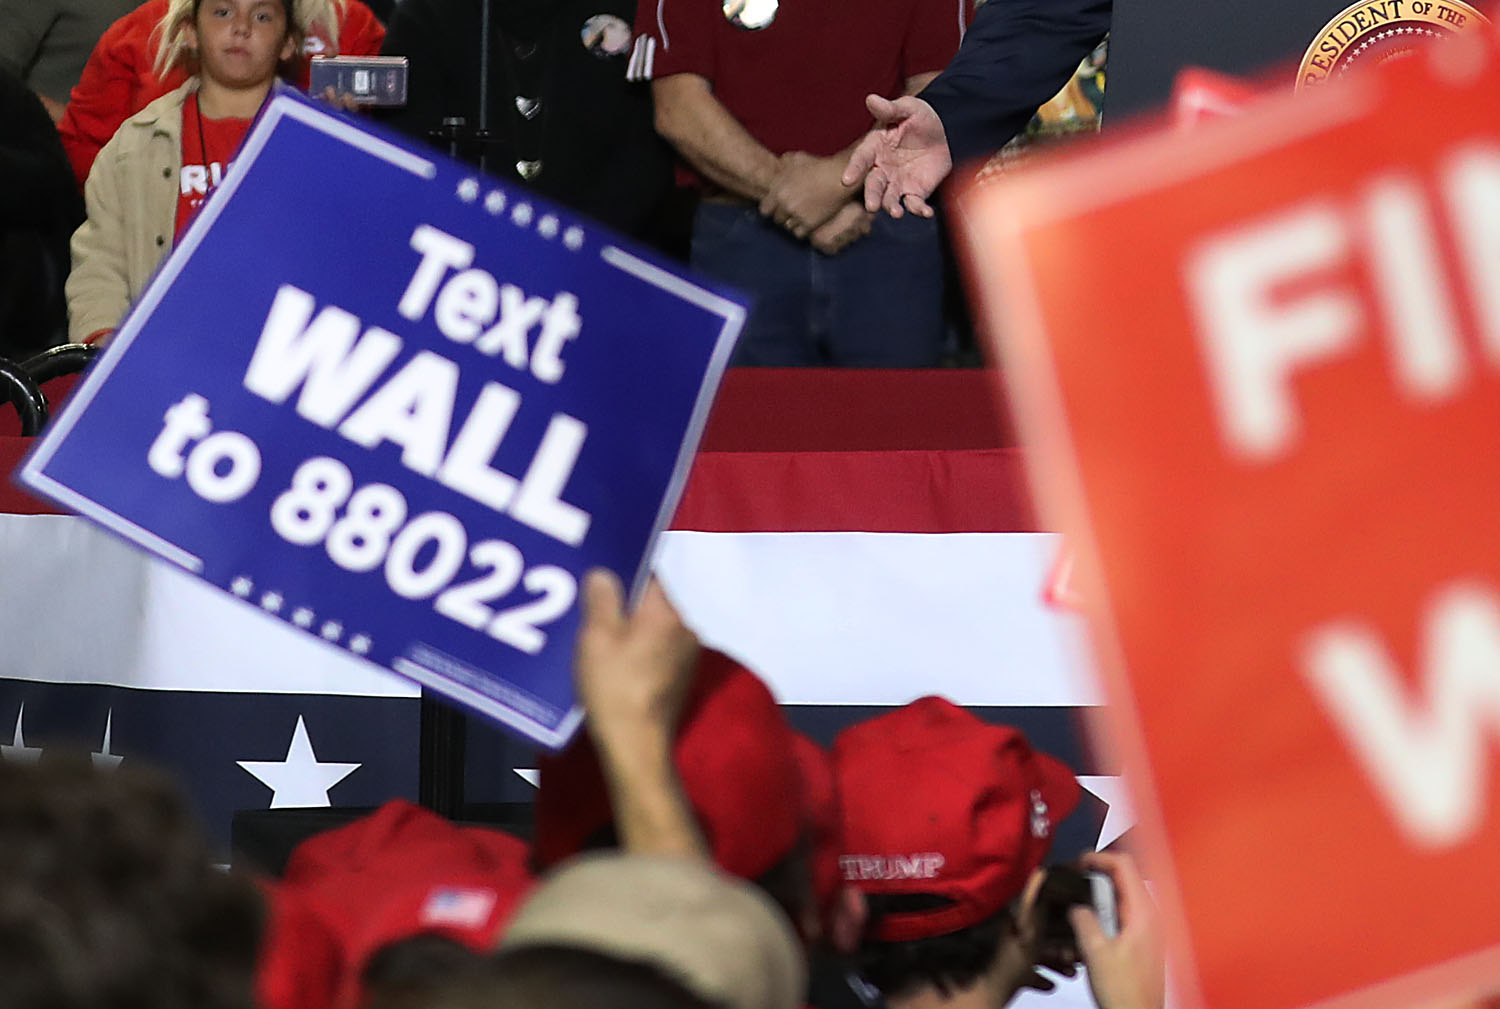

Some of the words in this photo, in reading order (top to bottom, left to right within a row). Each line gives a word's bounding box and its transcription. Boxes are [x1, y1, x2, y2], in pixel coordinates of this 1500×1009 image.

[1304, 0, 1403, 87] RESIDENT
[1412, 1, 1433, 16] OF
[1437, 5, 1467, 29] THE
[399, 224, 582, 384] Text
[244, 284, 591, 546] WALL
[148, 394, 262, 503] to
[271, 457, 578, 656] 88022
[838, 843, 946, 881] TRUMP
